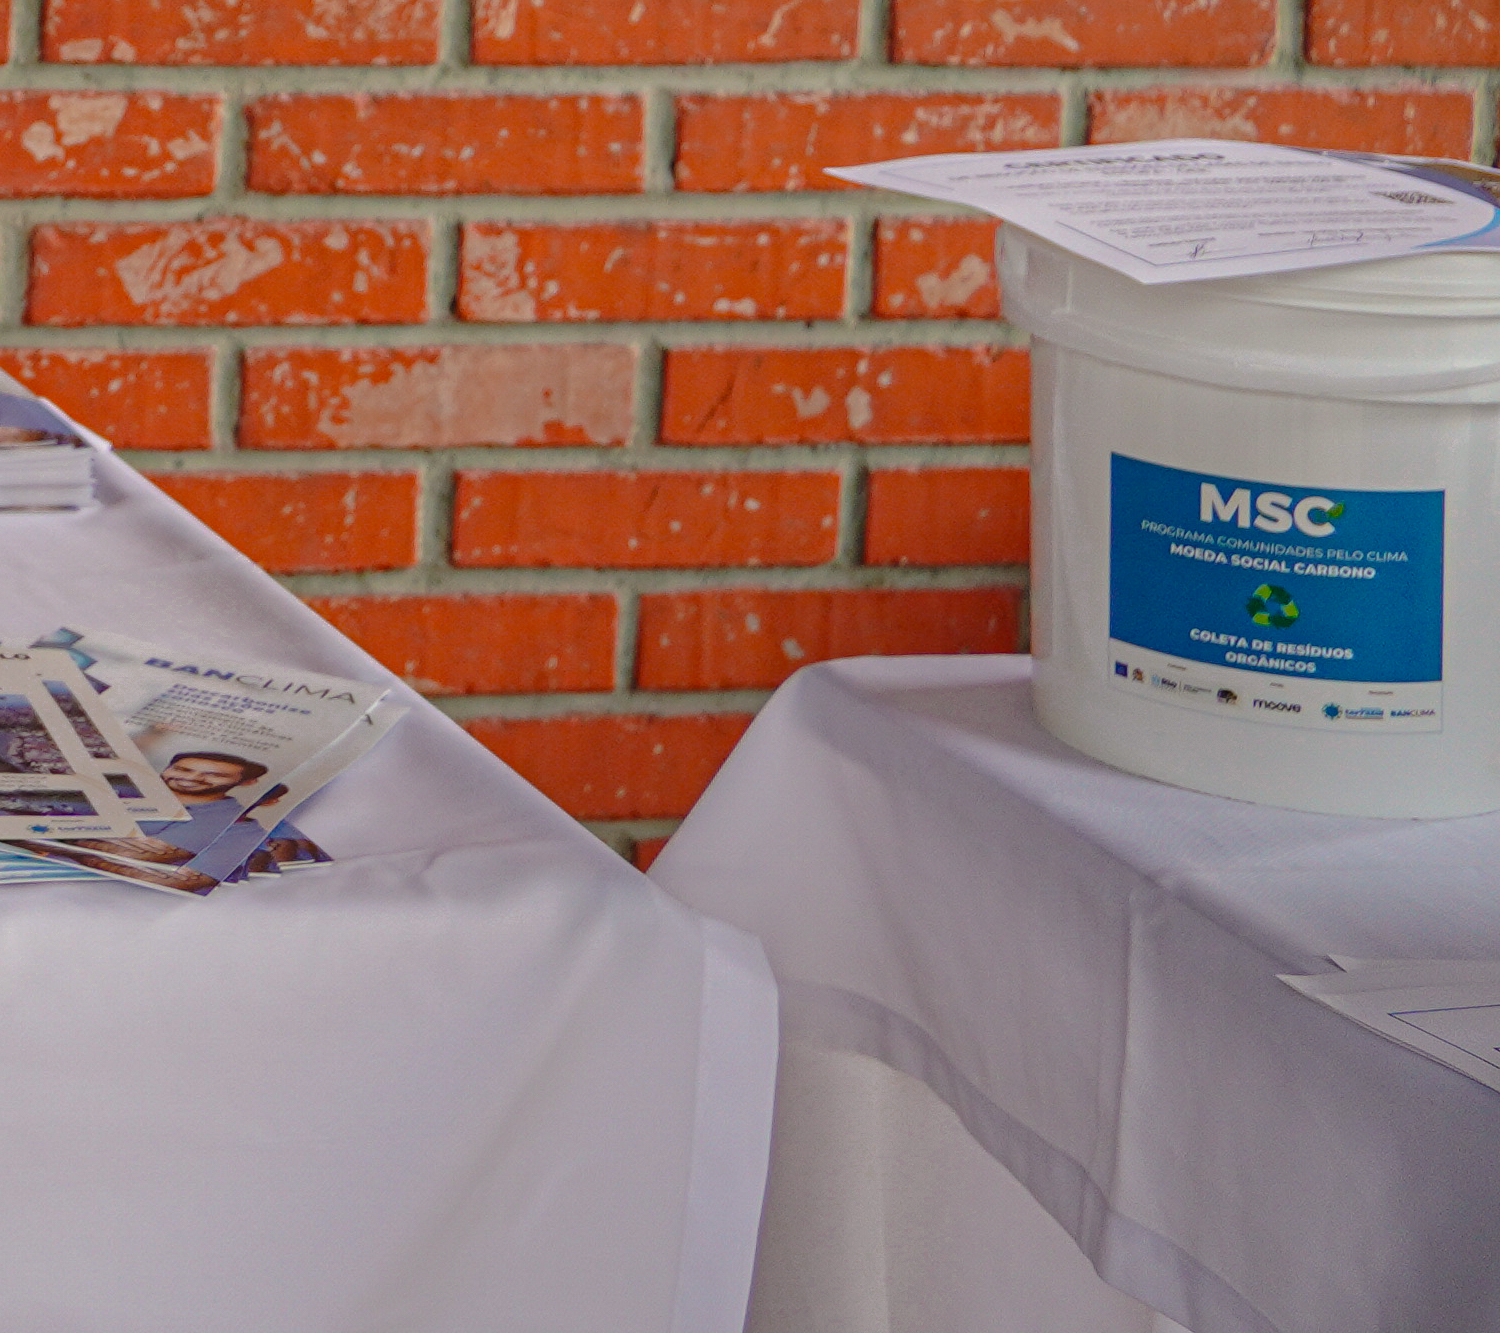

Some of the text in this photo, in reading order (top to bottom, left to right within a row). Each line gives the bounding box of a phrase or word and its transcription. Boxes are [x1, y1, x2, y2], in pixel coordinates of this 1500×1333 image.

[1199, 482, 1336, 538] MSC
[1140, 518, 1409, 564] PROGRAMA COMUNIDADES PELO CLIMA
[1169, 541, 1377, 581] MOEDA SOCIAL CARBONO
[1189, 627, 1355, 661] COLETA DE RESÍDUOS
[1224, 650, 1317, 675] ORGÂNICOS
[144, 657, 358, 705] BANCLIMA
[1252, 698, 1302, 713] moove
